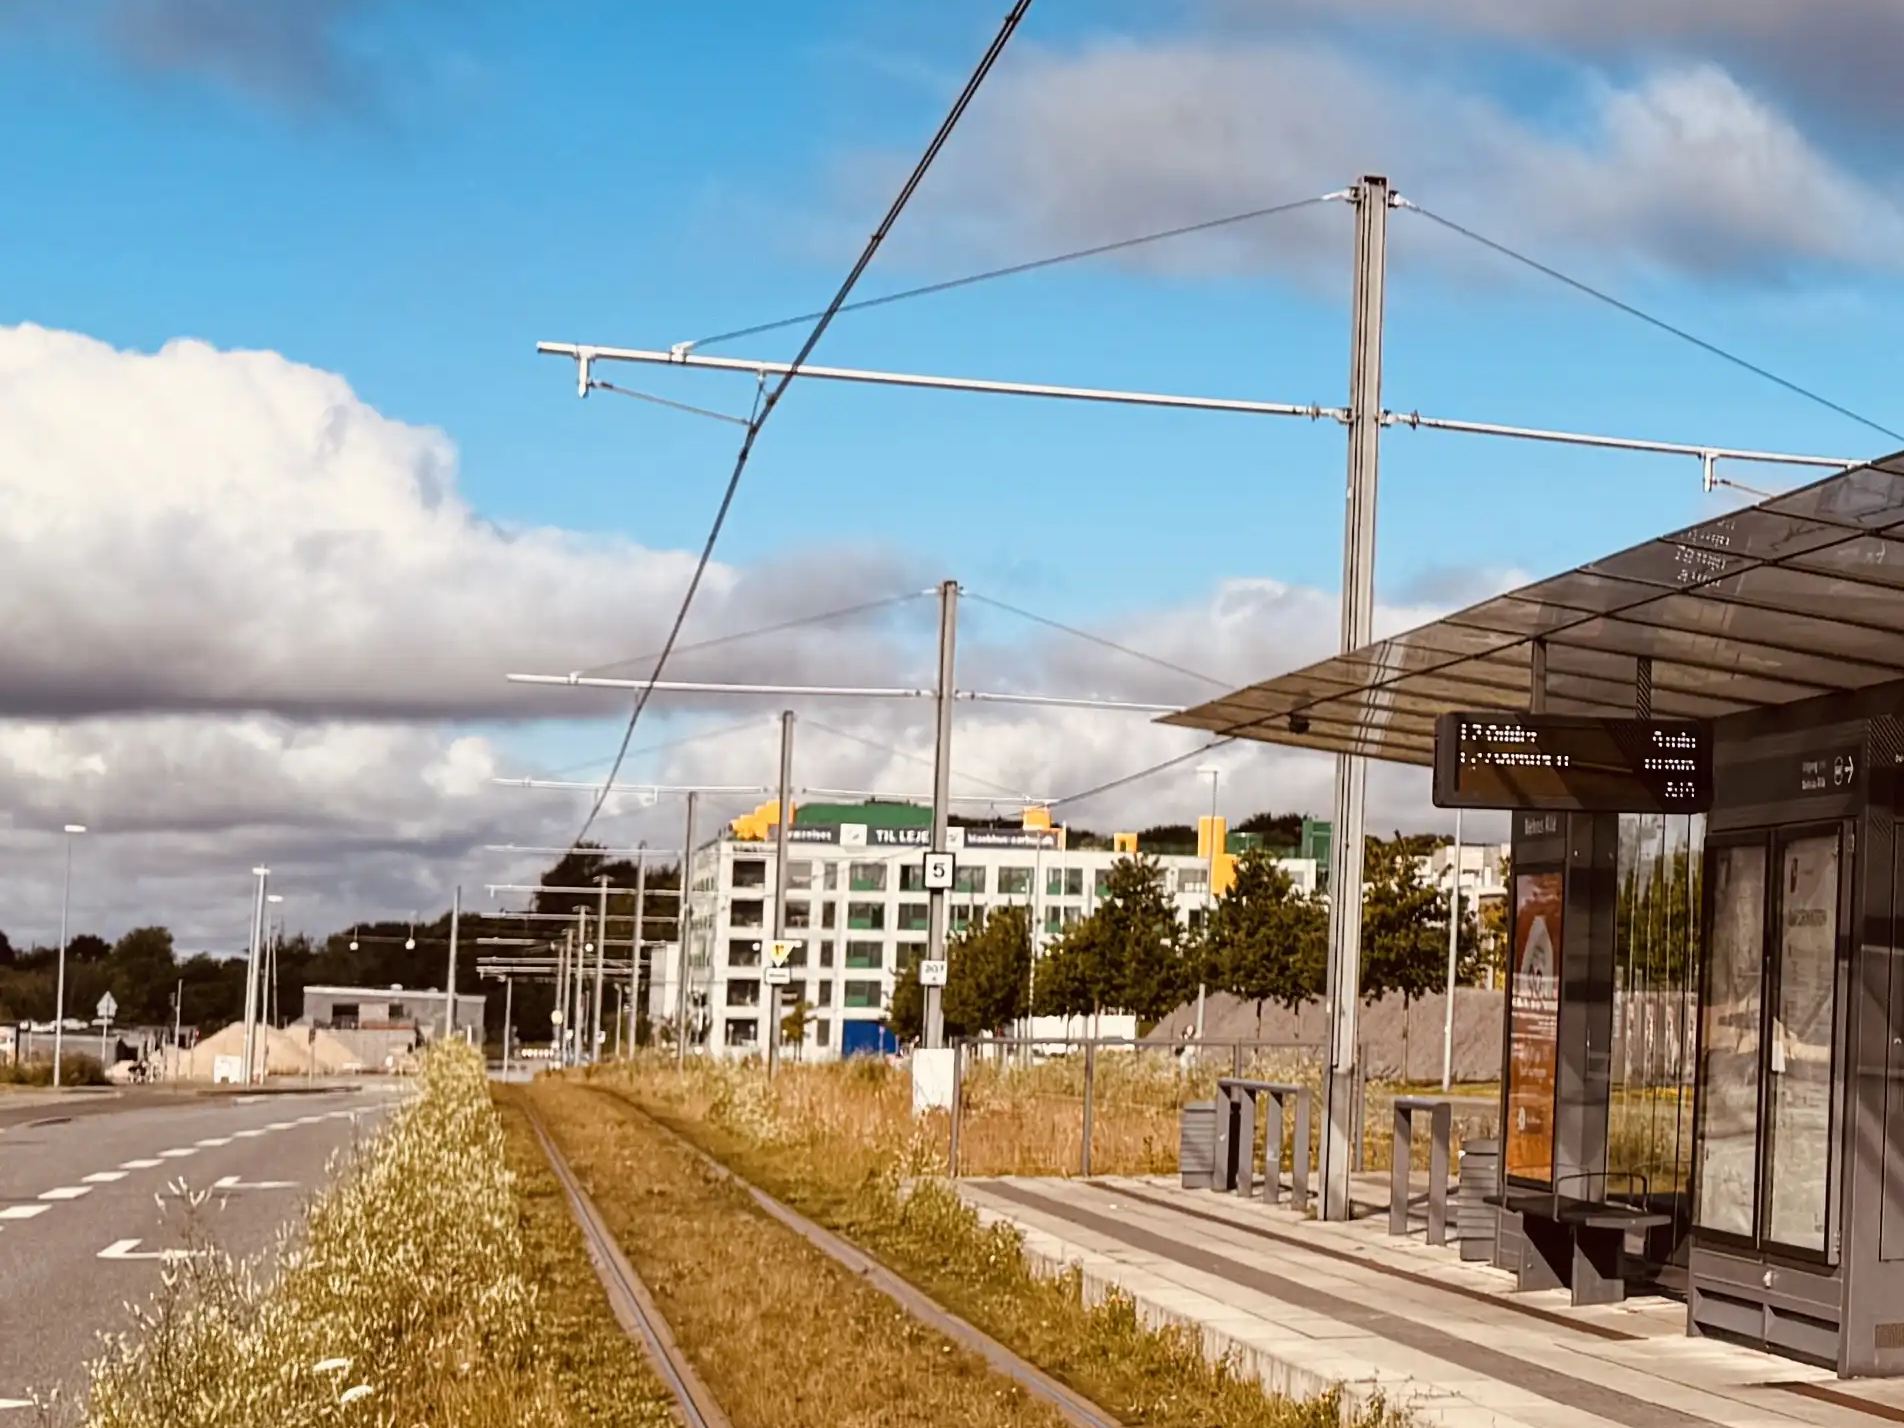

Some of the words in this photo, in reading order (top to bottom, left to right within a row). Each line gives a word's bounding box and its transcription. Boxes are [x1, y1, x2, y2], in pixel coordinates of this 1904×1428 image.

[875, 829, 897, 843] TIL
[899, 829, 930, 844] LEJE
[933, 862, 945, 878] 5
